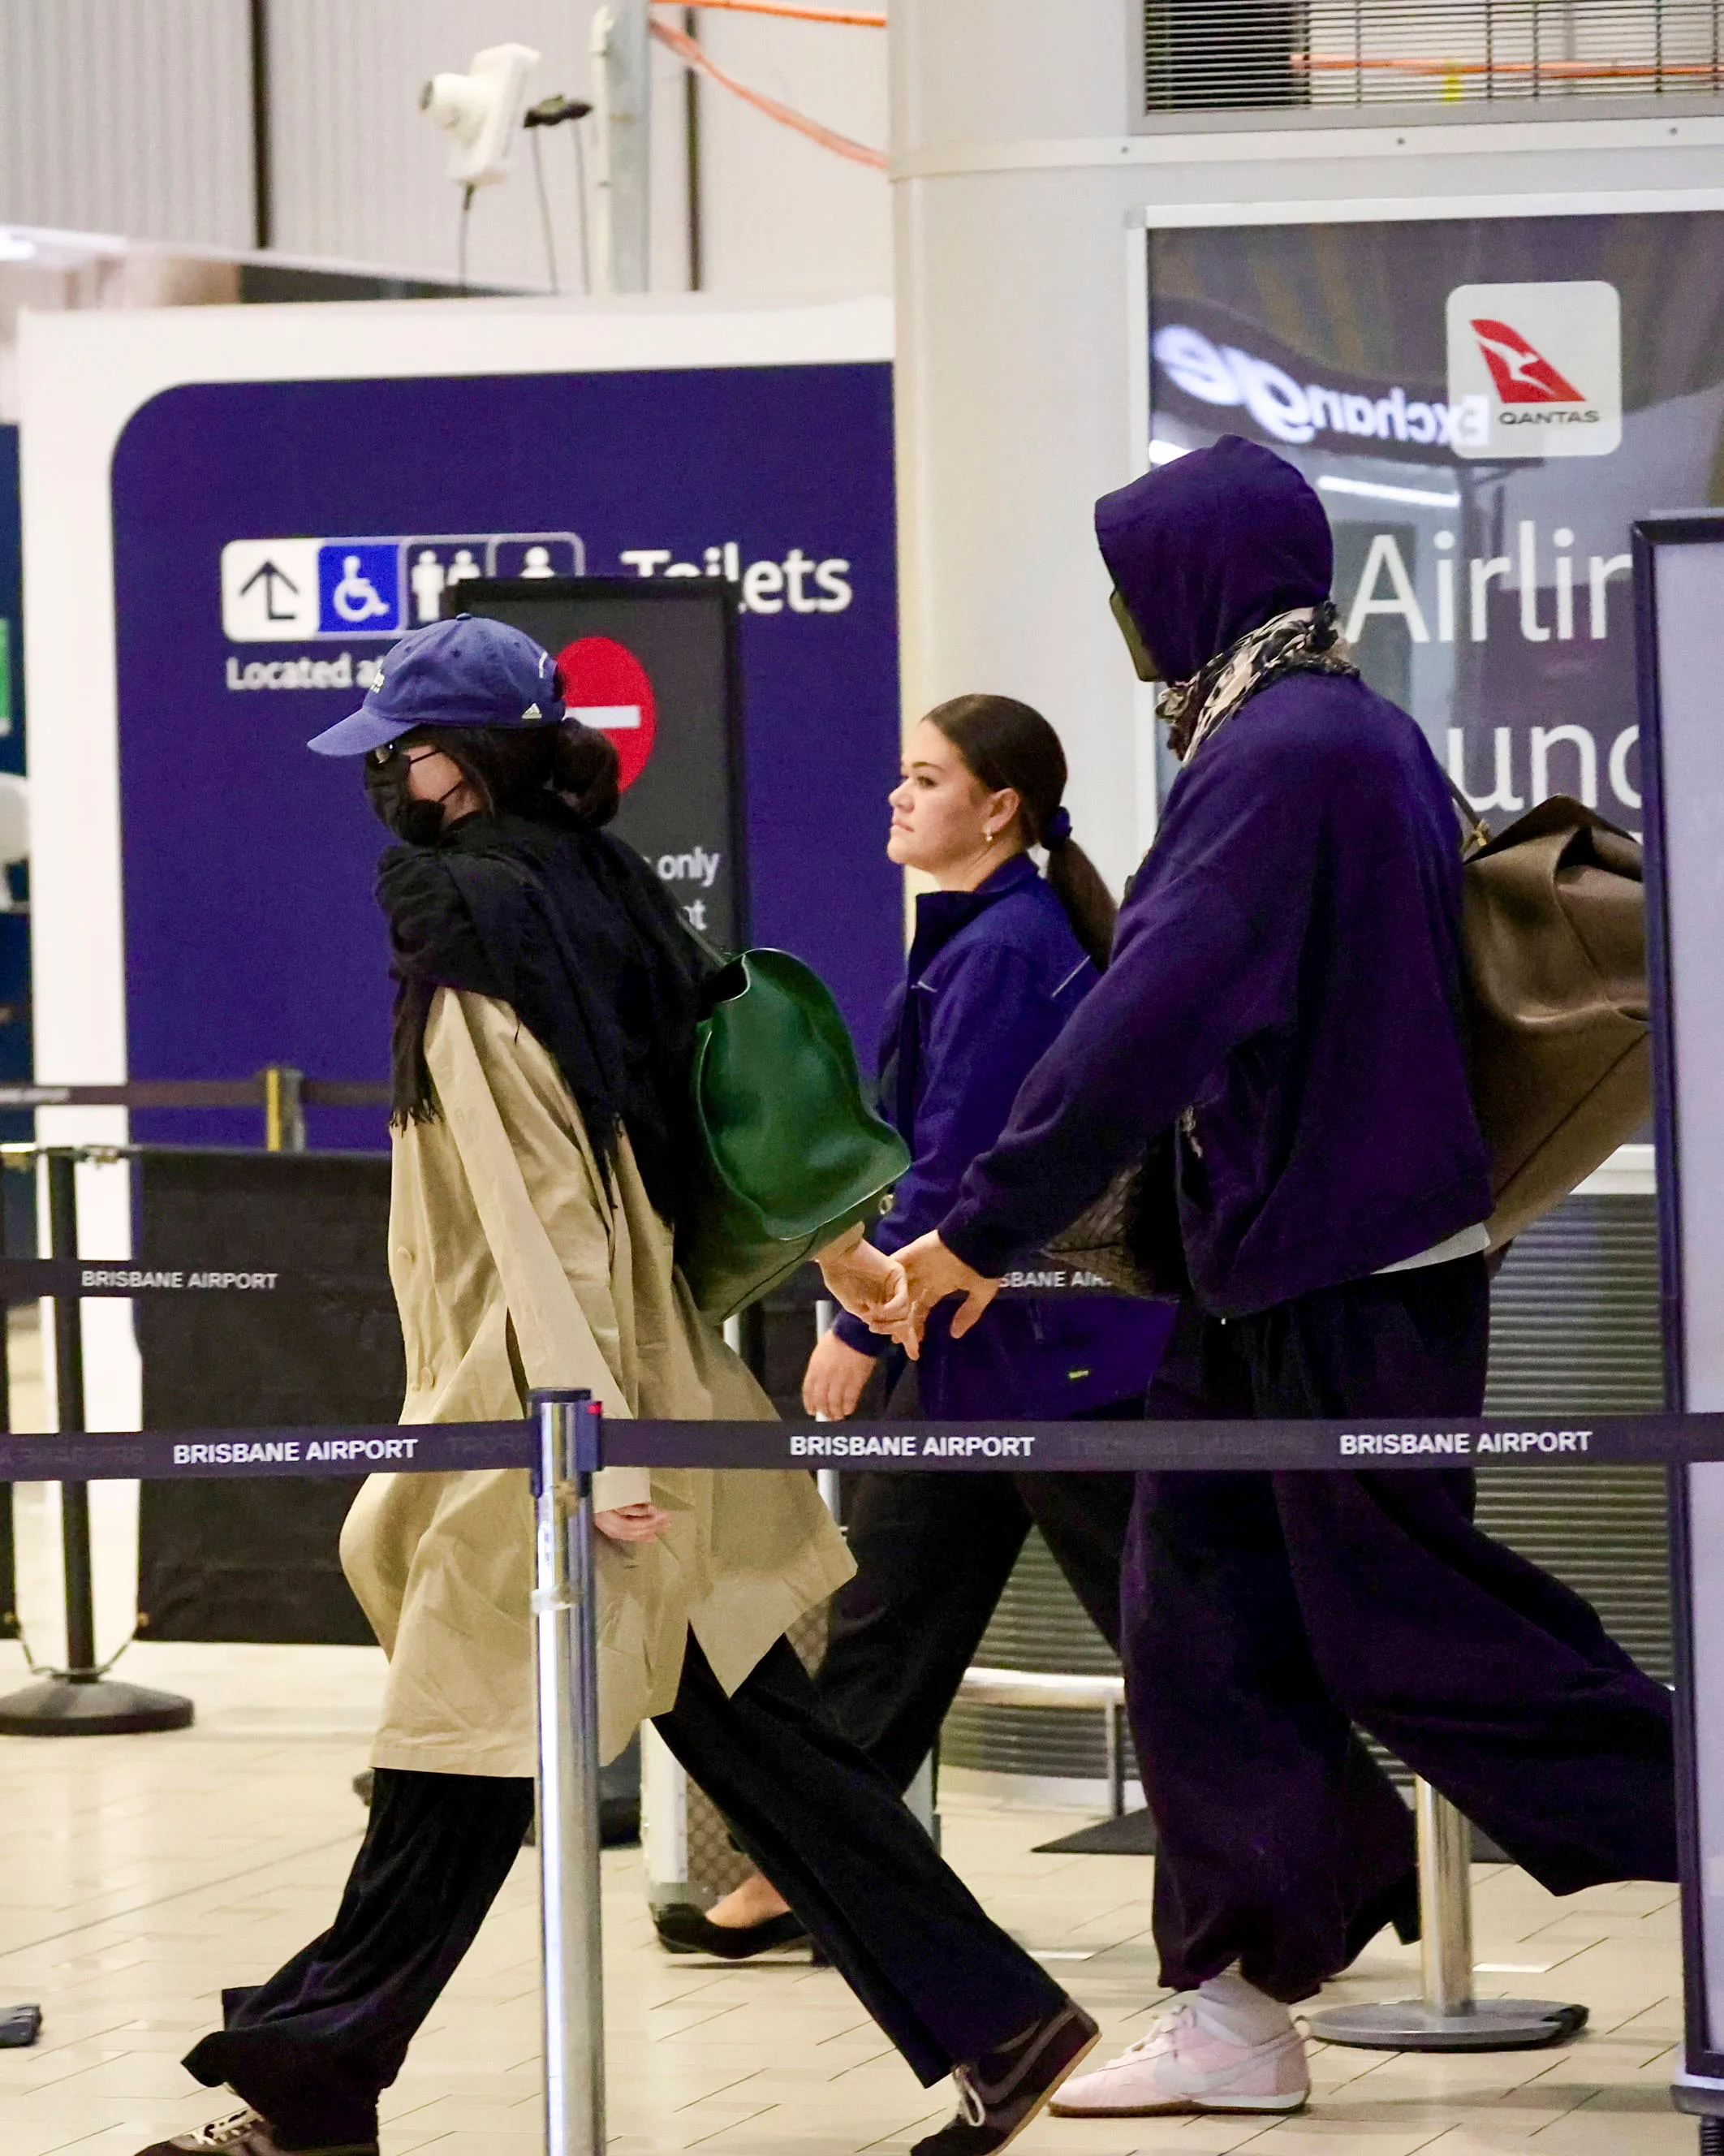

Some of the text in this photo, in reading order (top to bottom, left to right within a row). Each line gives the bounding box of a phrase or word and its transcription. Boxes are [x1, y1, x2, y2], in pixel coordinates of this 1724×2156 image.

[1498, 409, 1601, 426] QANTAS
[227, 653, 354, 690] Located
[657, 846, 721, 887] only
[81, 1270, 278, 1289] BRISBANE AIRPORT
[173, 1442, 300, 1464] BRISBANE
[305, 1438, 419, 1461] AIRPORT
[790, 1436, 1036, 1456] BRISBANE AIRPORT
[1339, 1434, 1471, 1455] BRISBANE
[1476, 1430, 1593, 1453] AIRPORT
